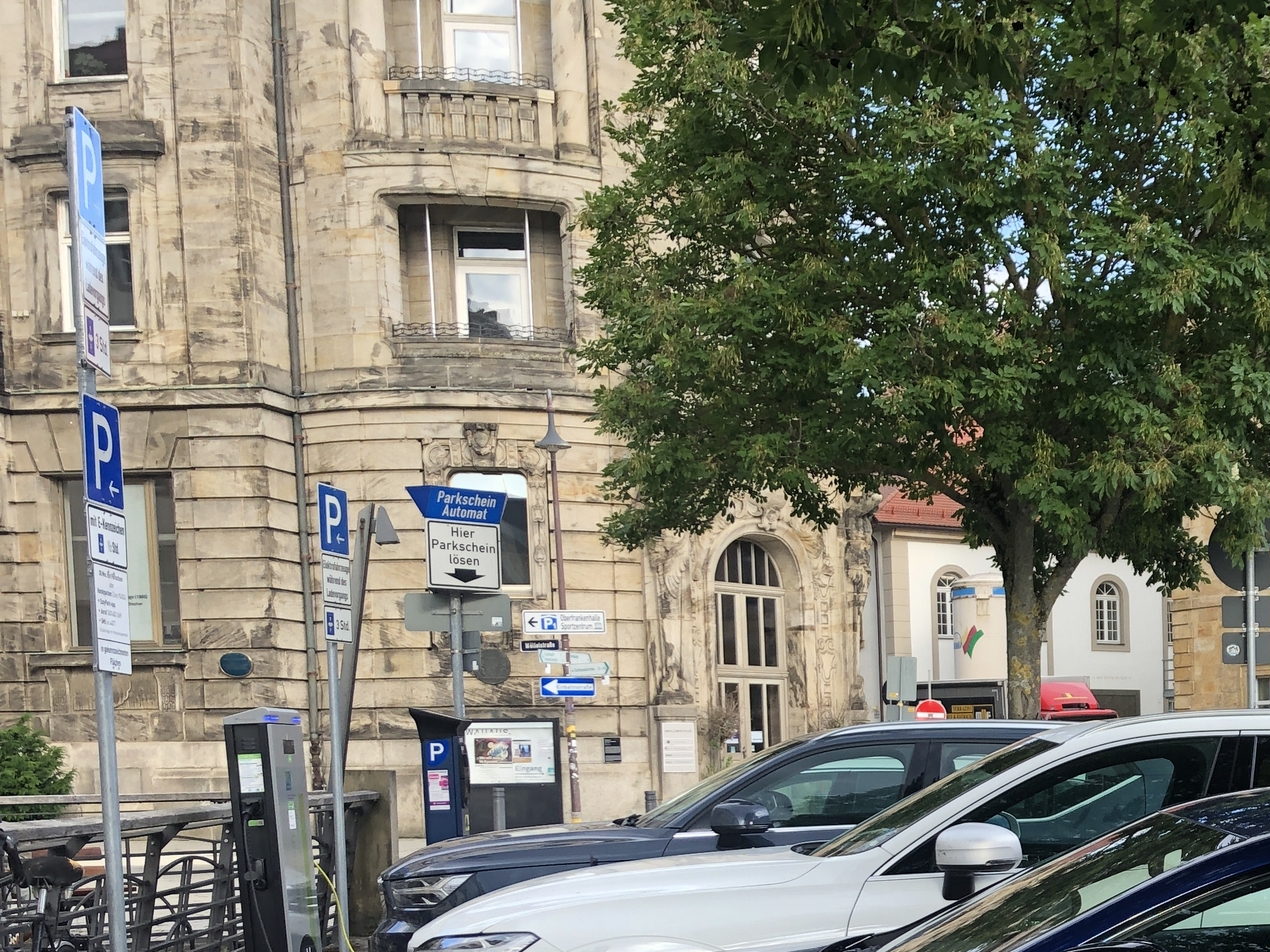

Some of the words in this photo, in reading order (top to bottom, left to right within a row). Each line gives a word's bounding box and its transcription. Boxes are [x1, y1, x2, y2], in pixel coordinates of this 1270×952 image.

[80, 131, 97, 209] P
[92, 411, 113, 490] P
[436, 490, 497, 509] Parkschein
[324, 494, 342, 544] P
[441, 504, 488, 520] Automat
[451, 526, 475, 538] Hier
[431, 539, 496, 554] Parkschein
[449, 554, 480, 566] lösen
[335, 619, 340, 630] 3
[429, 743, 445, 762] P
